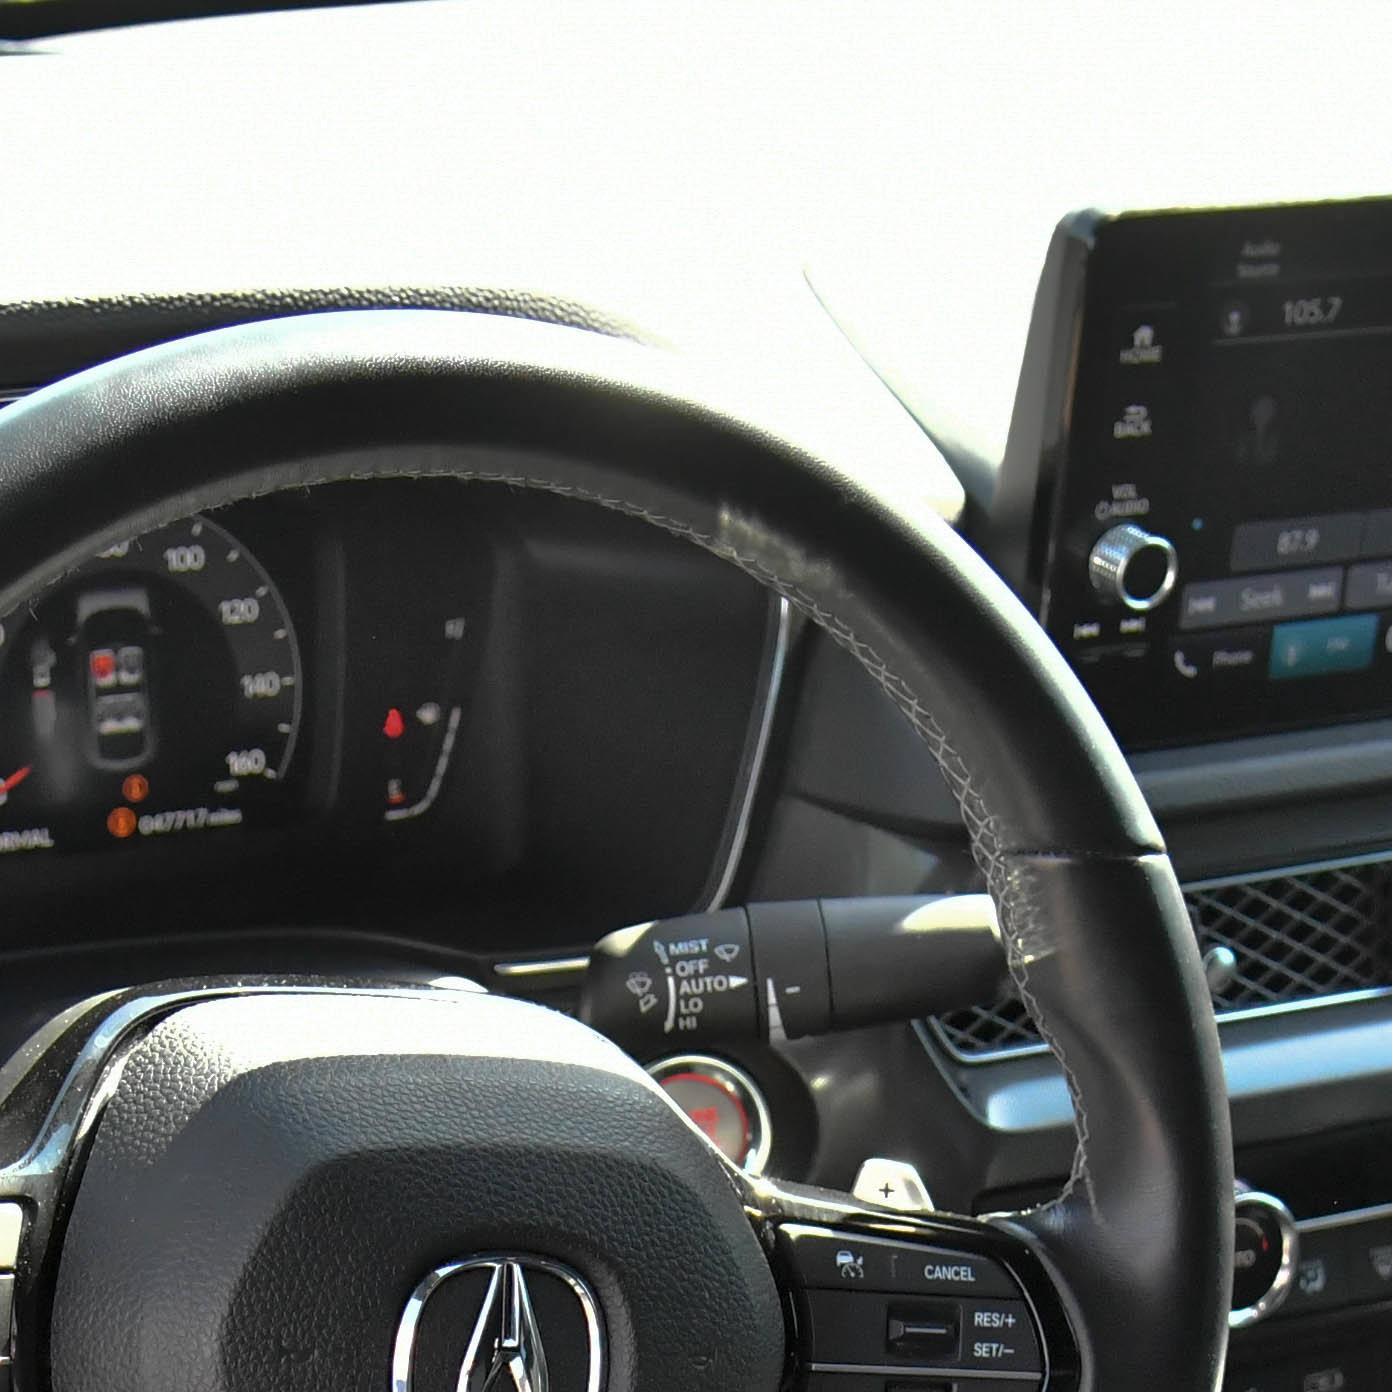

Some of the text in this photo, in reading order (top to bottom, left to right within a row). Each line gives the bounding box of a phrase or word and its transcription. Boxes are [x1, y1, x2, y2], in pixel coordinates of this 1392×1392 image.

[1282, 297, 1343, 326] 105.7
[164, 545, 205, 573] 100
[218, 597, 260, 626] 120
[240, 671, 281, 700] 140
[226, 748, 267, 778] 160
[668, 938, 709, 956] MIST
[675, 959, 709, 978] OFF
[679, 976, 728, 995] AUTO
[679, 997, 703, 1014] LO
[679, 1015, 697, 1031] HI
[924, 1265, 976, 1282] CANCEL
[974, 1311, 1016, 1329] RES/+
